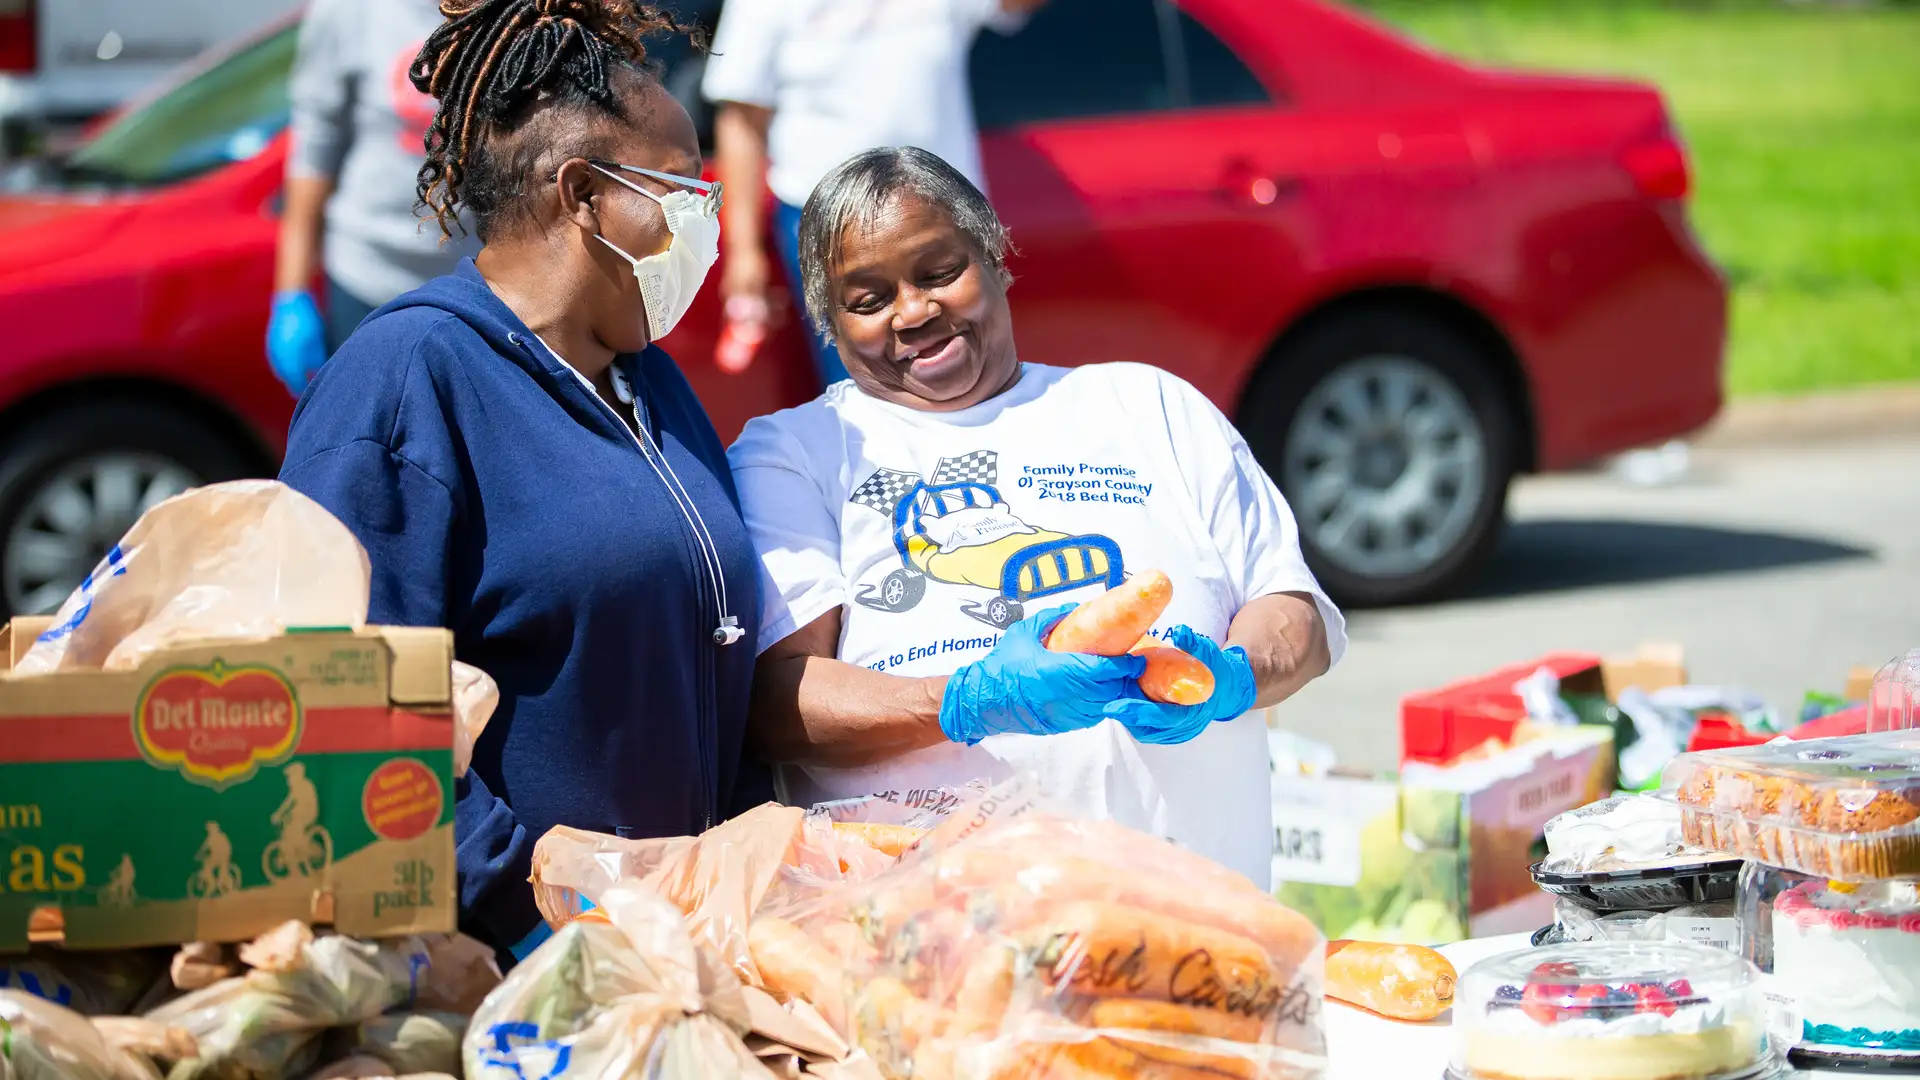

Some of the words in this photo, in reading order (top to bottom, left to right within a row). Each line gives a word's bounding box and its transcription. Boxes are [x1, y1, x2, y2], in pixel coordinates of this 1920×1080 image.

[1023, 464, 1074, 477] Family
[1079, 463, 1136, 479] Promise
[1080, 492, 1109, 502] Bed
[1113, 492, 1147, 506] Race
[1105, 479, 1153, 497] County
[889, 653, 904, 667] to
[908, 641, 938, 662] End
[942, 633, 1002, 653] Homel
[153, 698, 196, 730] Del
[201, 698, 288, 729] Monte
[0, 843, 86, 893] as
[373, 889, 434, 918] pack
